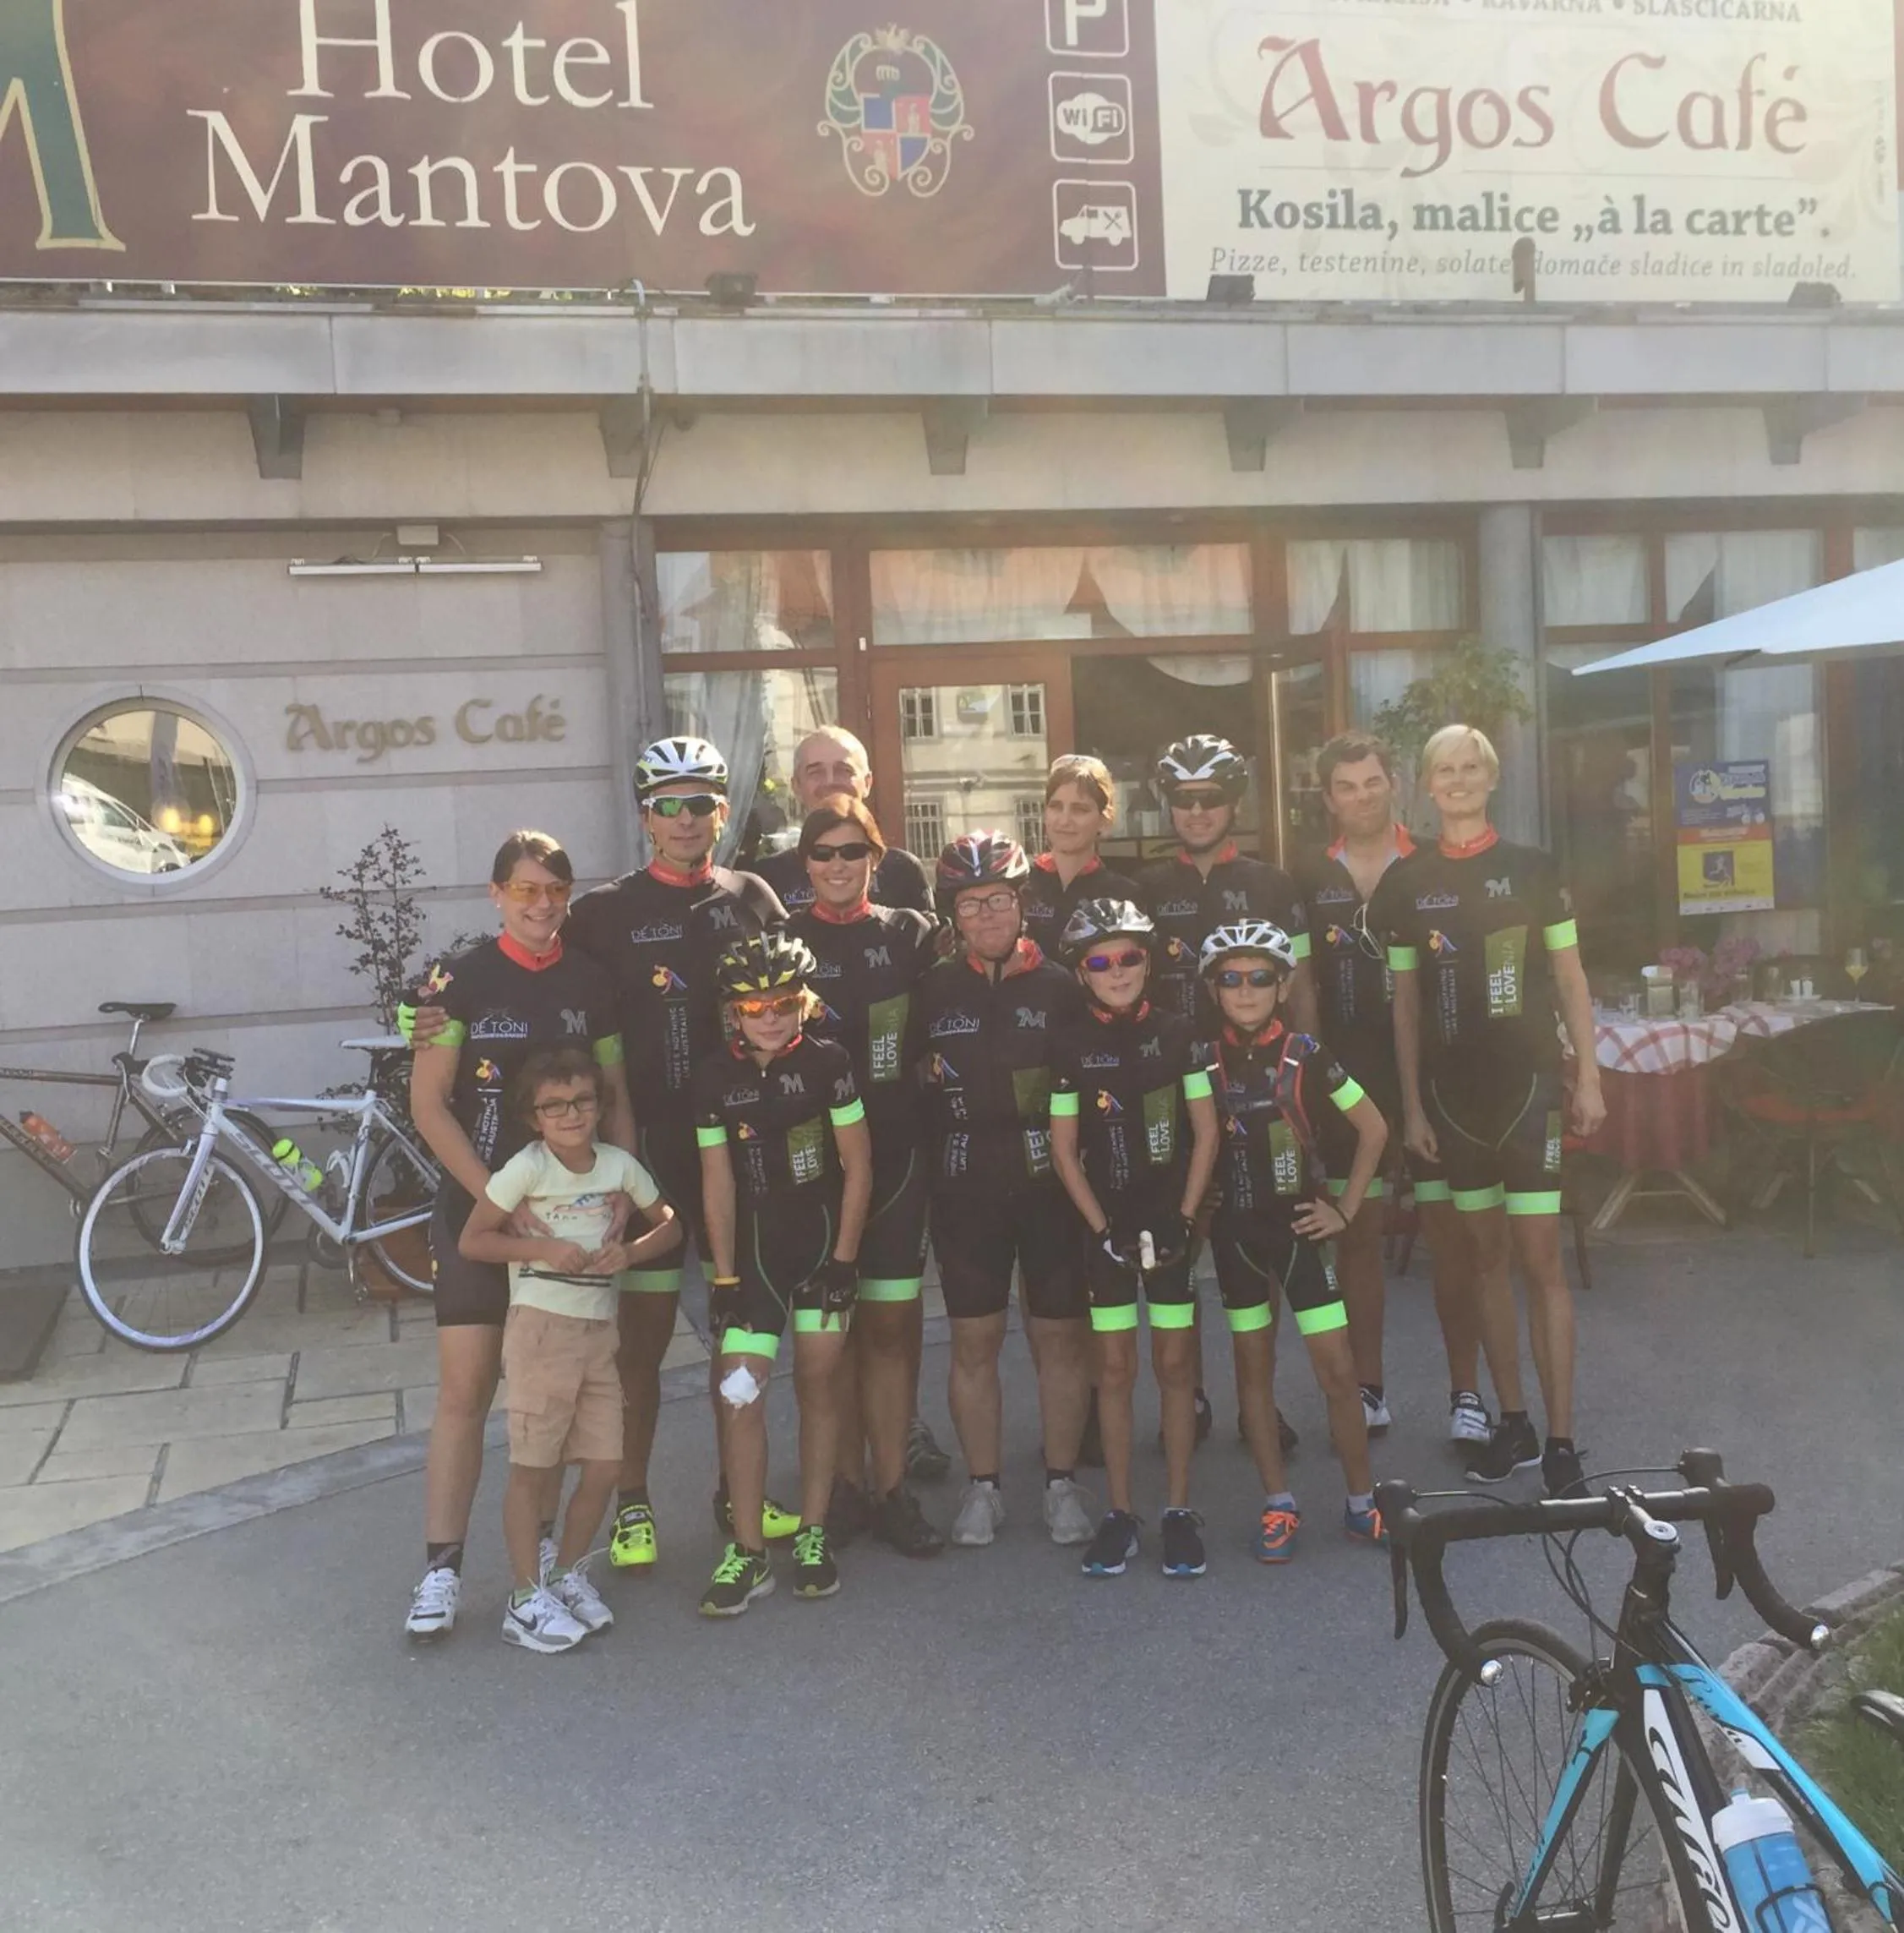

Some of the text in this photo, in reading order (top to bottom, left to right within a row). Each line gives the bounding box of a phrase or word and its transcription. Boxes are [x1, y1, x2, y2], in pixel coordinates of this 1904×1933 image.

[287, 0, 654, 108] Hotel
[1258, 35, 1555, 178] Argos
[1599, 52, 1809, 155] Café
[187, 109, 756, 237] Mantova
[1237, 188, 1399, 241] Kosila,
[1413, 192, 1560, 233] malice
[1633, 194, 1673, 235] la
[1210, 247, 1288, 275] Pizze,
[1299, 250, 1426, 276] testenine,
[1629, 250, 1713, 277] sladice
[1722, 253, 1743, 276] in
[1752, 251, 1858, 280] sladoled.
[285, 693, 567, 763] Argos Café
[1489, 969, 1504, 1005] FEEL
[491, 1019, 528, 1034] TONI
[872, 1035, 885, 1069] FEEL
[1148, 1123, 1160, 1154] FEEL
[792, 1149, 806, 1177] FEEL
[1274, 1152, 1286, 1183] FEEL
